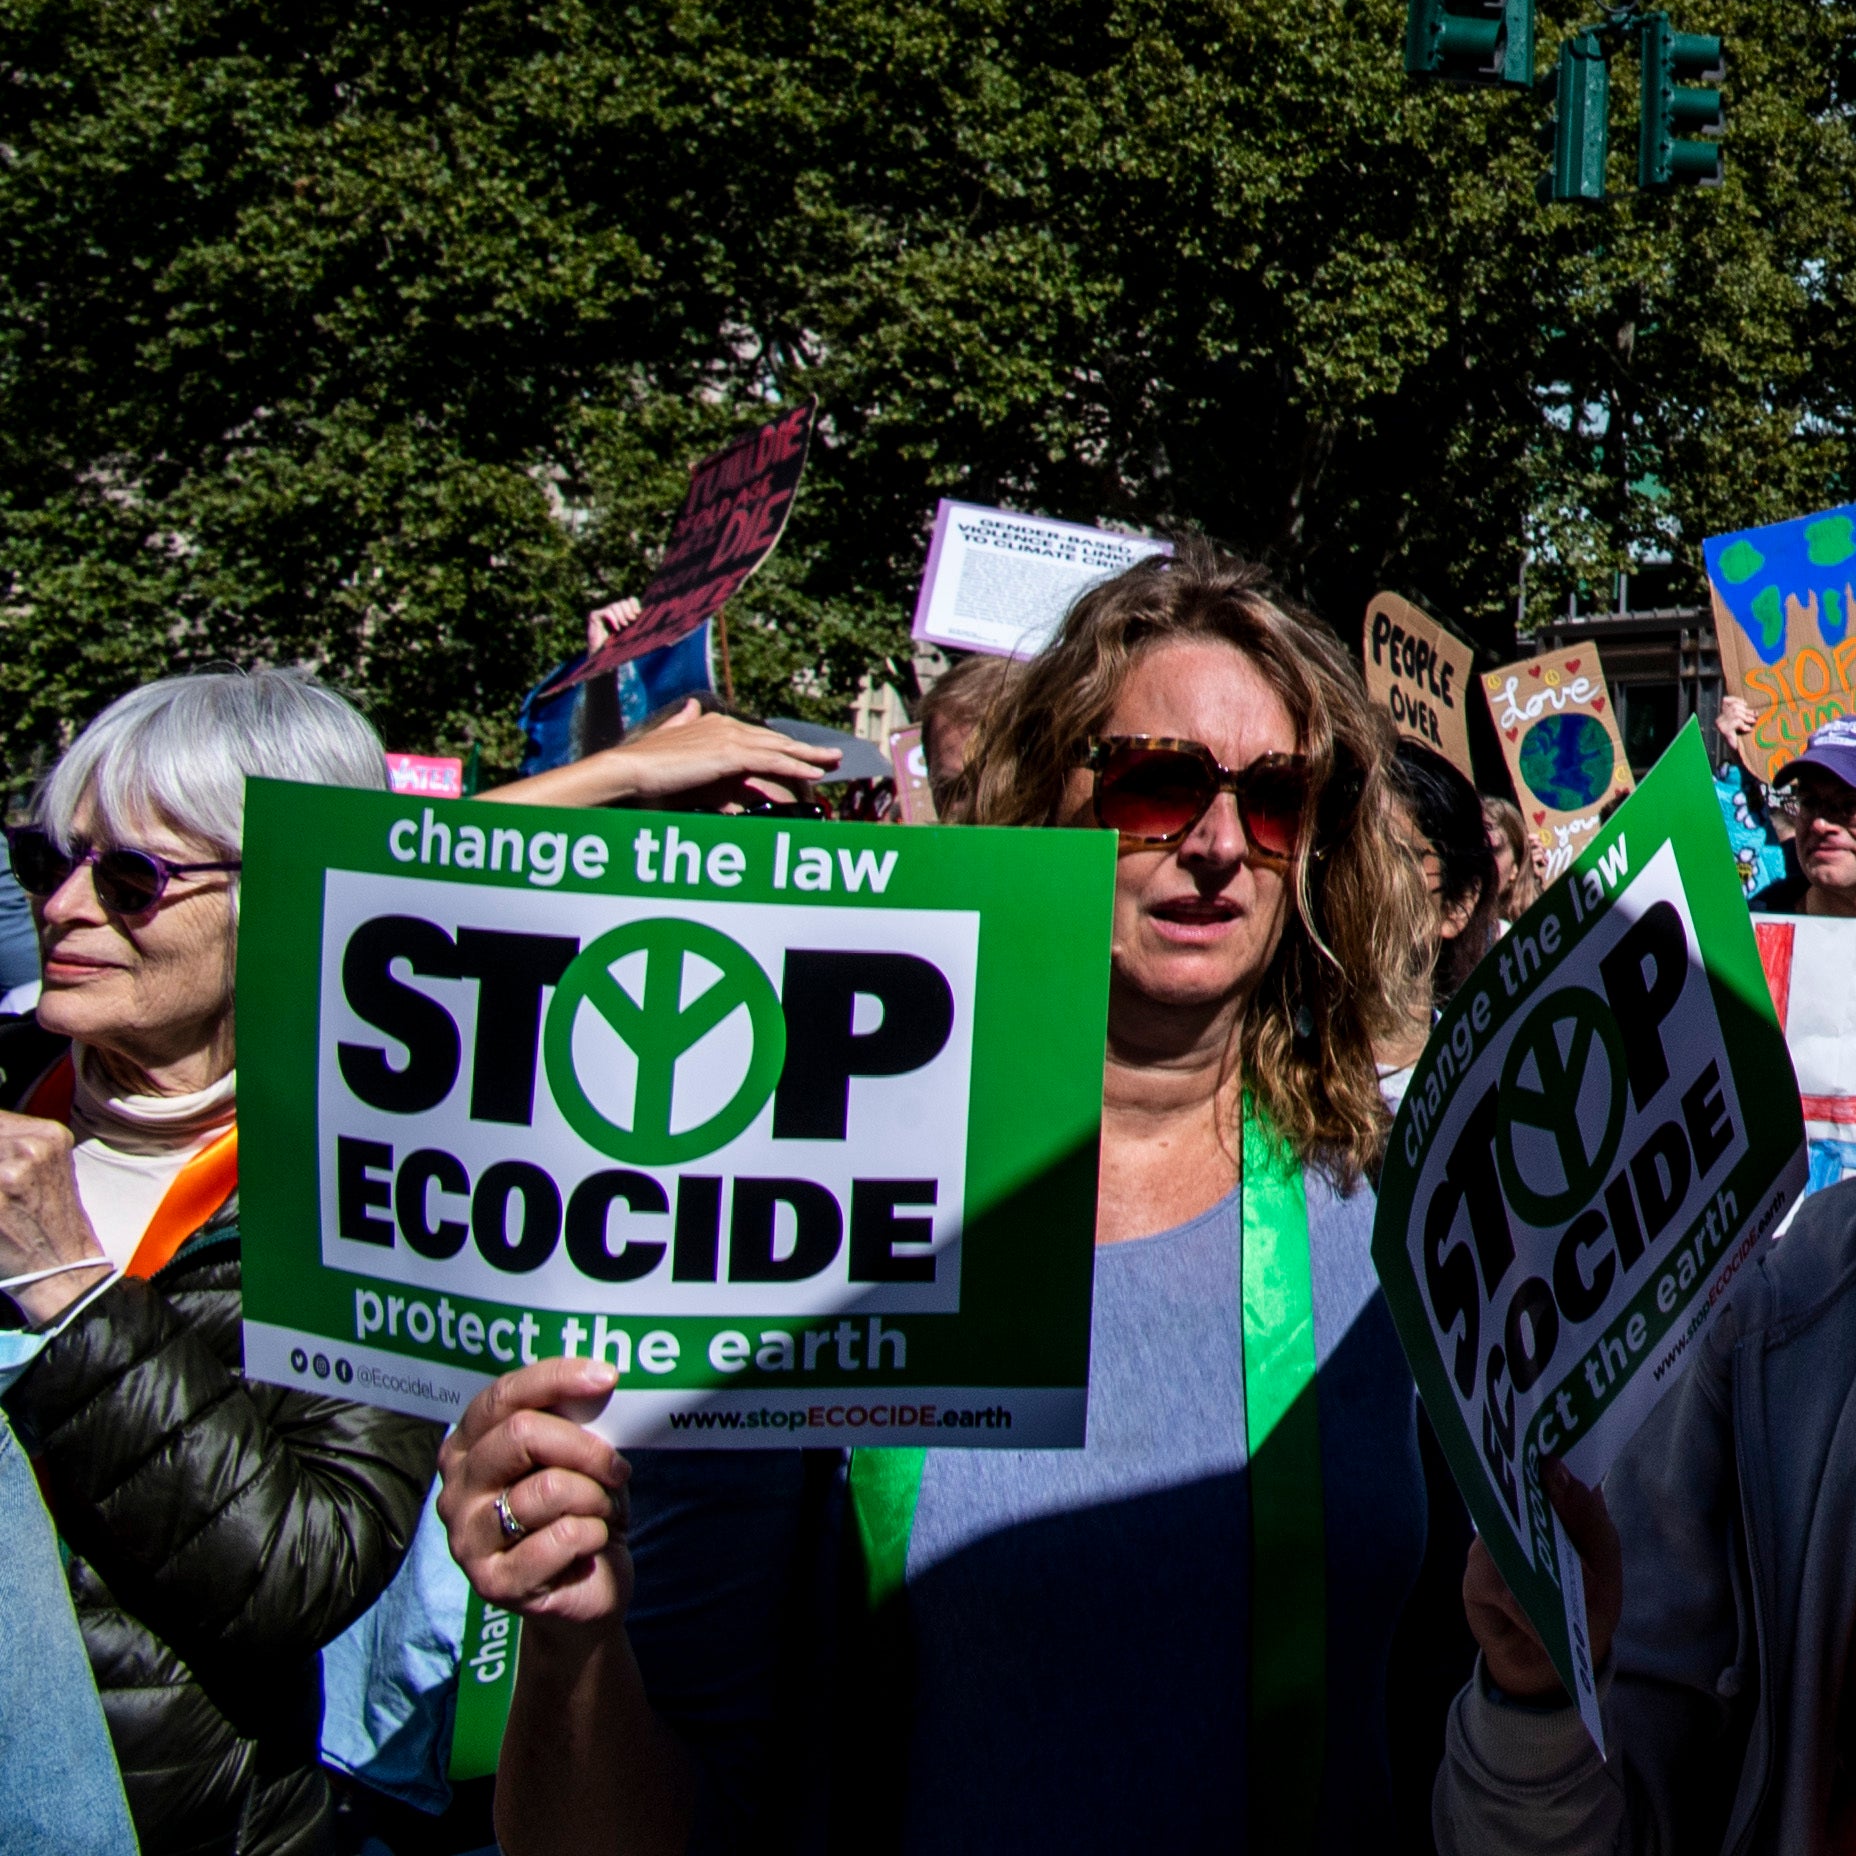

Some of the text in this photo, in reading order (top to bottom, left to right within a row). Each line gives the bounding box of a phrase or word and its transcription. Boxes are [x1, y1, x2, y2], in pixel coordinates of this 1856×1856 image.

[958, 523, 1135, 563] VIOLENCE IS LINKE
[962, 534, 988, 545] TO
[993, 541, 1076, 562] CLIMATE
[980, 519, 1131, 554] GENDER-BASED
[1371, 611, 1454, 709] PEOPLE
[1490, 676, 1600, 729] Love
[1390, 684, 1443, 749] OVER
[389, 808, 898, 893] change the law
[337, 913, 955, 1167] STOP
[1405, 990, 1492, 1168] change
[1500, 913, 1561, 996] the
[1569, 832, 1629, 923] law
[1424, 900, 1689, 1401] STOP
[338, 1135, 939, 1285] ECOCIDE
[1483, 1057, 1735, 1533] ECOCIDE
[1584, 1313, 1648, 1399] the
[1655, 1187, 1739, 1314] earth
[1653, 1188, 1786, 1382] www.stopECOCIDE.earth
[354, 1288, 908, 1374] protect the earth
[357, 1365, 462, 1406] @EcocideLaw
[670, 1406, 1013, 1431] www.stopECOCIDE.earth
